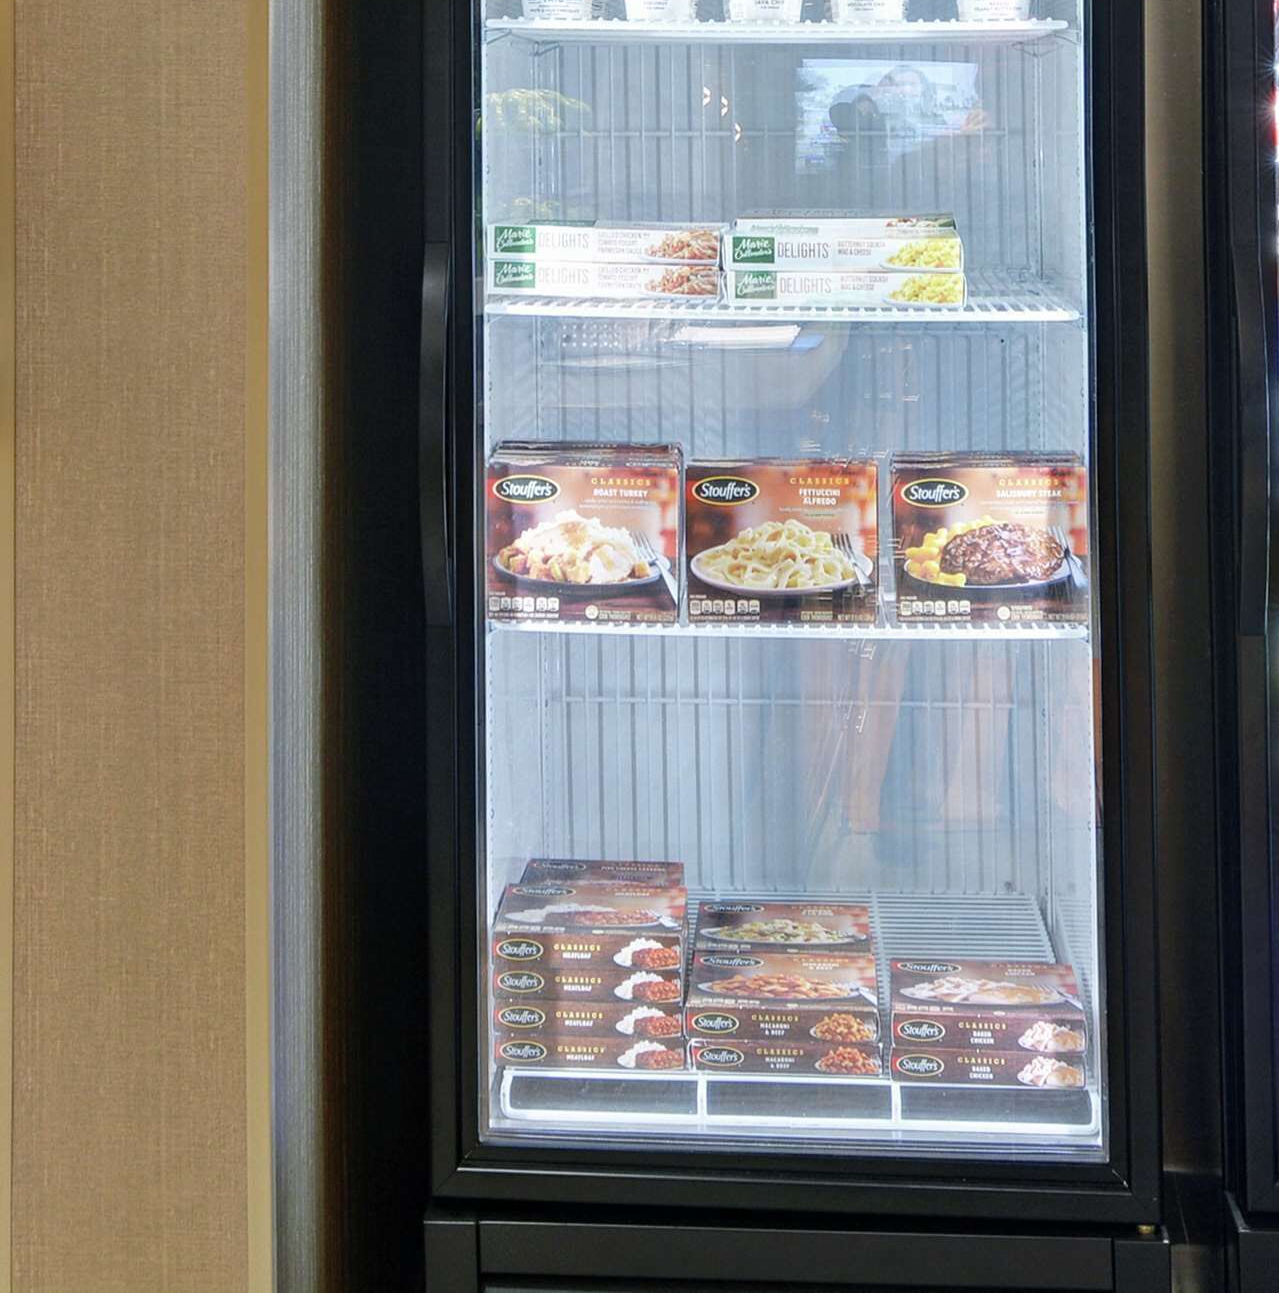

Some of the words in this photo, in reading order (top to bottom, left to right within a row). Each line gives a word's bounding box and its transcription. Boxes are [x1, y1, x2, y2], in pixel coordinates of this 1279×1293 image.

[538, 232, 590, 249] DELIGHTS
[777, 241, 830, 258] DELIGHTS
[538, 267, 590, 284] DELIGHTS
[779, 277, 832, 294] DELIGHTS
[500, 481, 553, 498] Stouffer's
[591, 478, 651, 487] CLASSICS
[619, 489, 648, 498] TURKEY
[700, 483, 751, 500] Stouffer's
[909, 484, 961, 502] Stouffer's
[803, 497, 837, 505] ALFREDO
[502, 942, 538, 957] Stouffer's
[553, 943, 602, 952] CLASSICS
[503, 975, 539, 989] Stouffer's
[555, 976, 603, 984] CLASSICS
[503, 1010, 540, 1024] Stouffer's
[556, 1011, 604, 1019] CLASSICS
[697, 1016, 734, 1030] Stouffer's
[751, 1014, 800, 1022] CLASSICS
[903, 1024, 940, 1038] Stouffer's
[958, 1021, 1007, 1030] CLASSICS
[505, 1045, 541, 1058] Stouffer's
[557, 1045, 605, 1053] CLASSICS
[702, 1050, 739, 1063] Stouffer's
[756, 1047, 805, 1055] CLASSICS
[901, 1058, 938, 1072] Stouffer's
[957, 1056, 1006, 1065] CLASSICS
